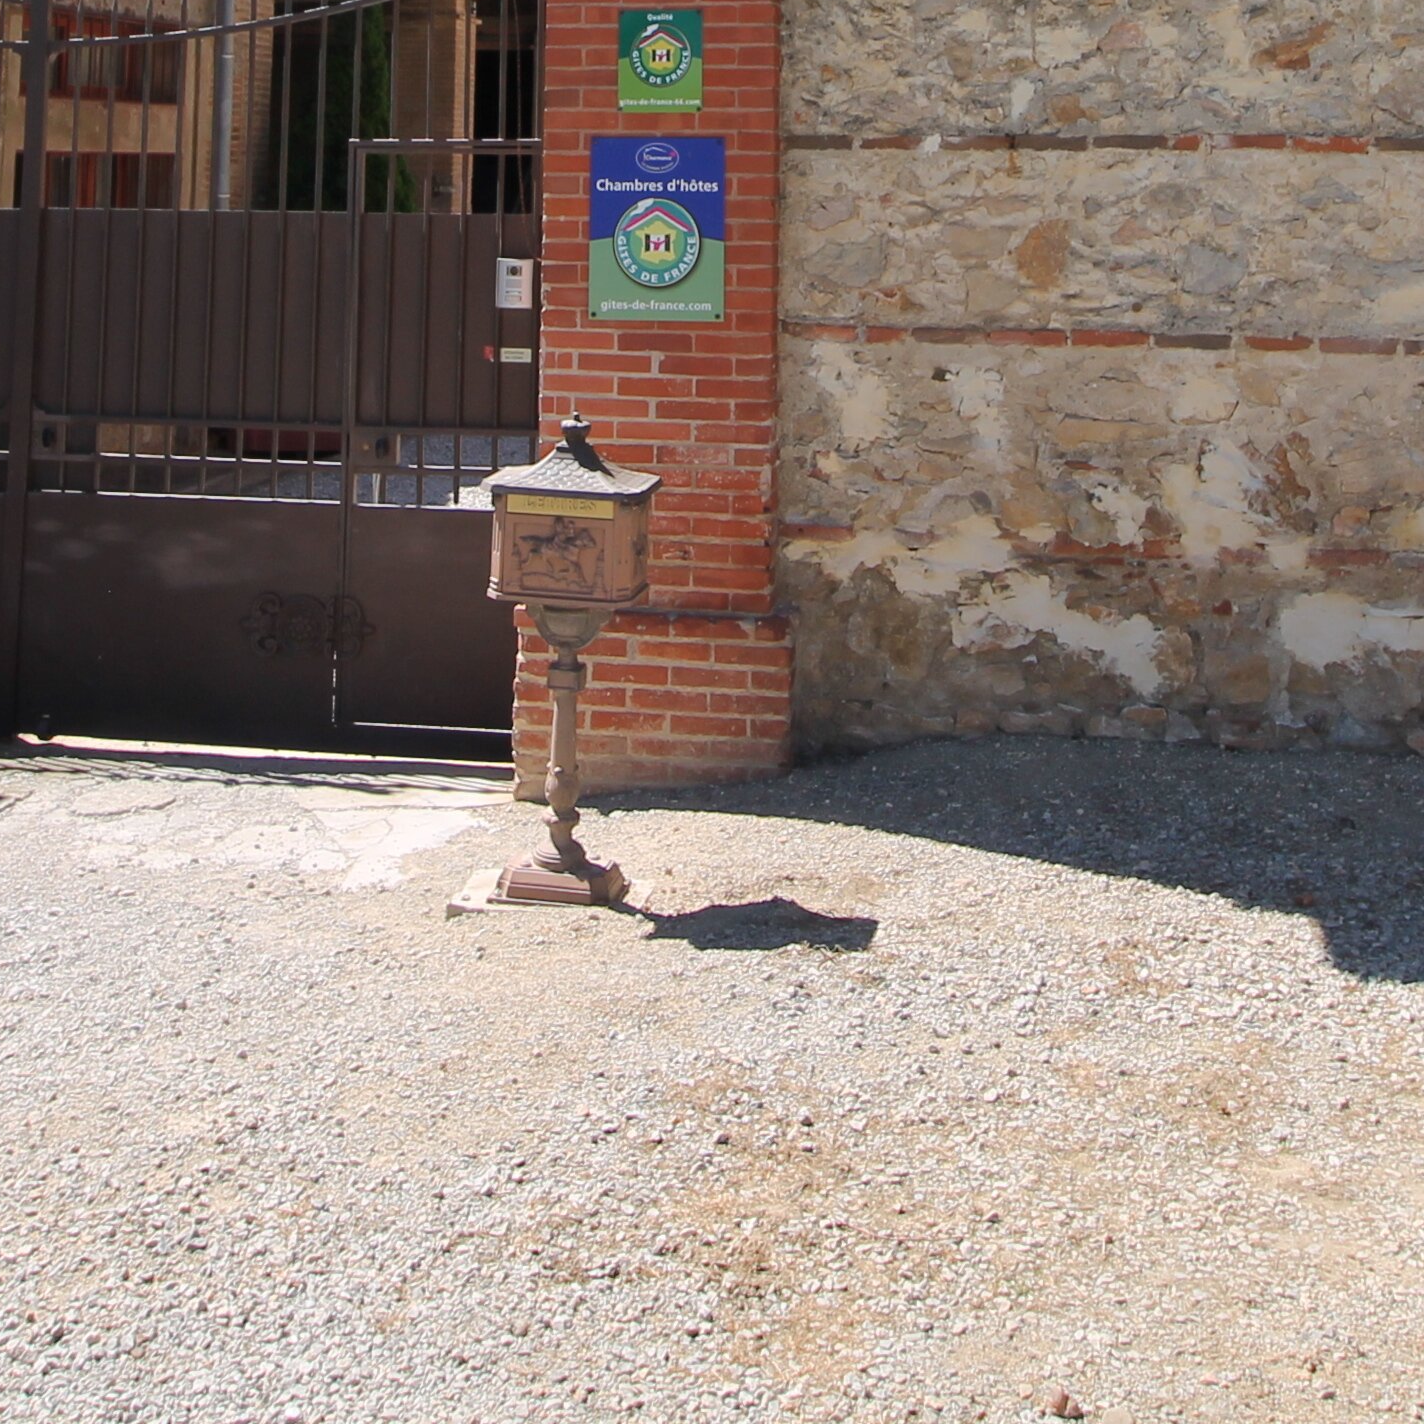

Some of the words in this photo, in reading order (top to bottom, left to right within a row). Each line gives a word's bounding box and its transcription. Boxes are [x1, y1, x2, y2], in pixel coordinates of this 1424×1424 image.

[646, 13, 674, 22] Qualité
[649, 75, 663, 85] DE
[665, 50, 690, 84] FRANCE
[596, 178, 664, 192] Chambres
[667, 179, 719, 192] d'hôtes
[640, 271, 659, 283] DE
[664, 236, 696, 282] FRANCE
[600, 299, 712, 311] gites-de-france.com
